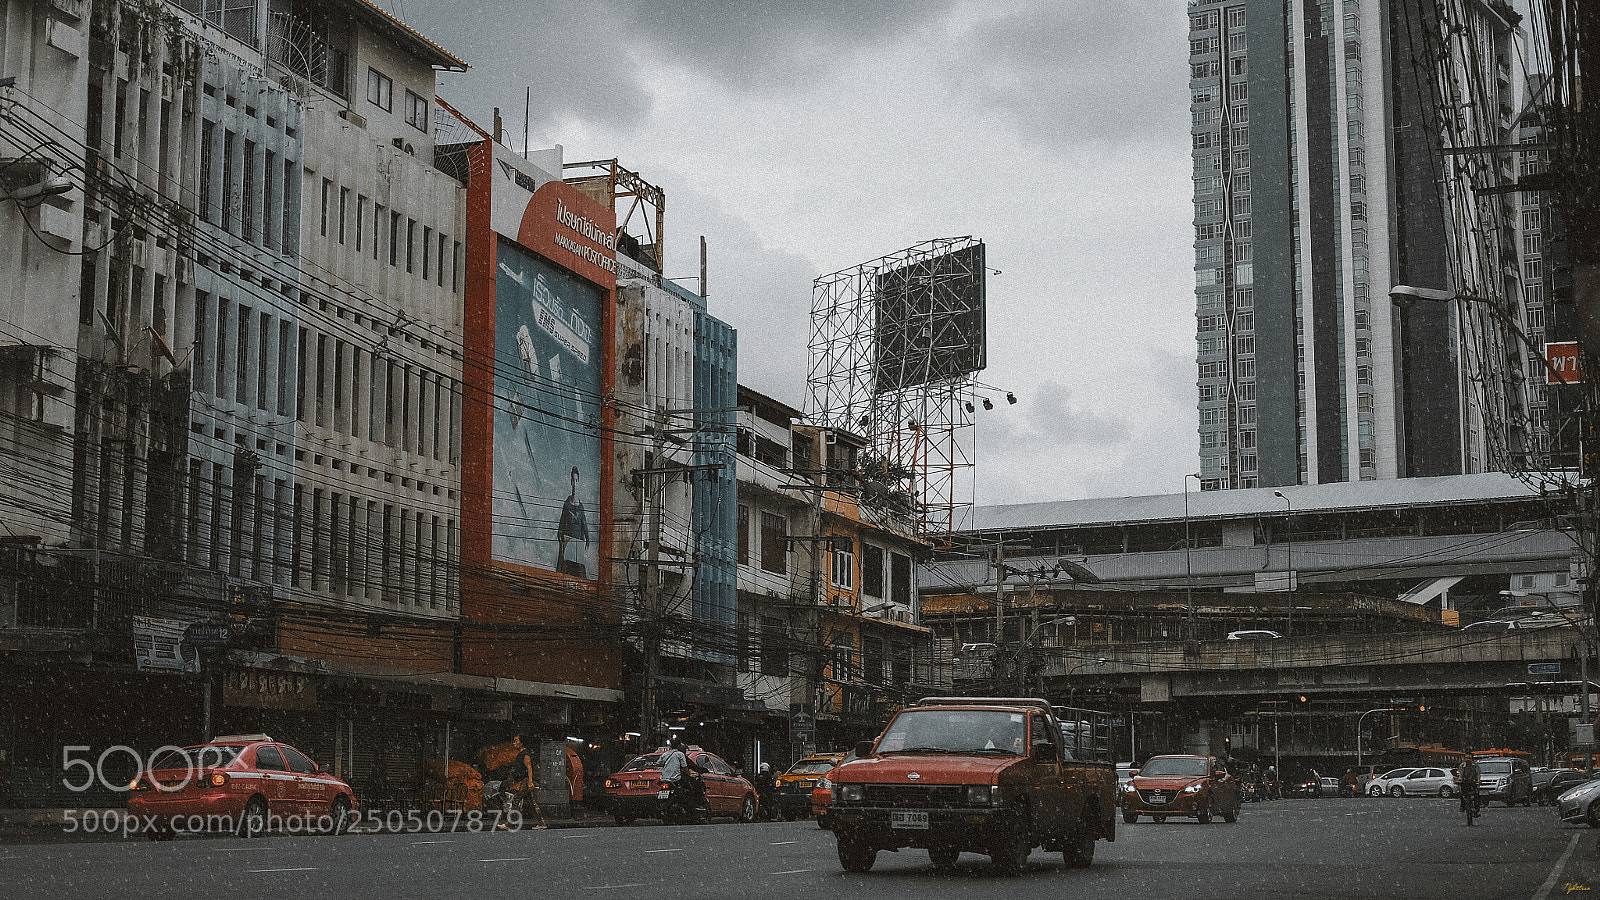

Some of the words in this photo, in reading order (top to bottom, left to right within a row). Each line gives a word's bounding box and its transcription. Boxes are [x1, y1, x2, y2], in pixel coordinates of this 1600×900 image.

[554, 232, 584, 258] MAKKASAN
[583, 245, 598, 265] POST
[597, 252, 617, 274] OFFICE
[219, 628, 228, 639] 12
